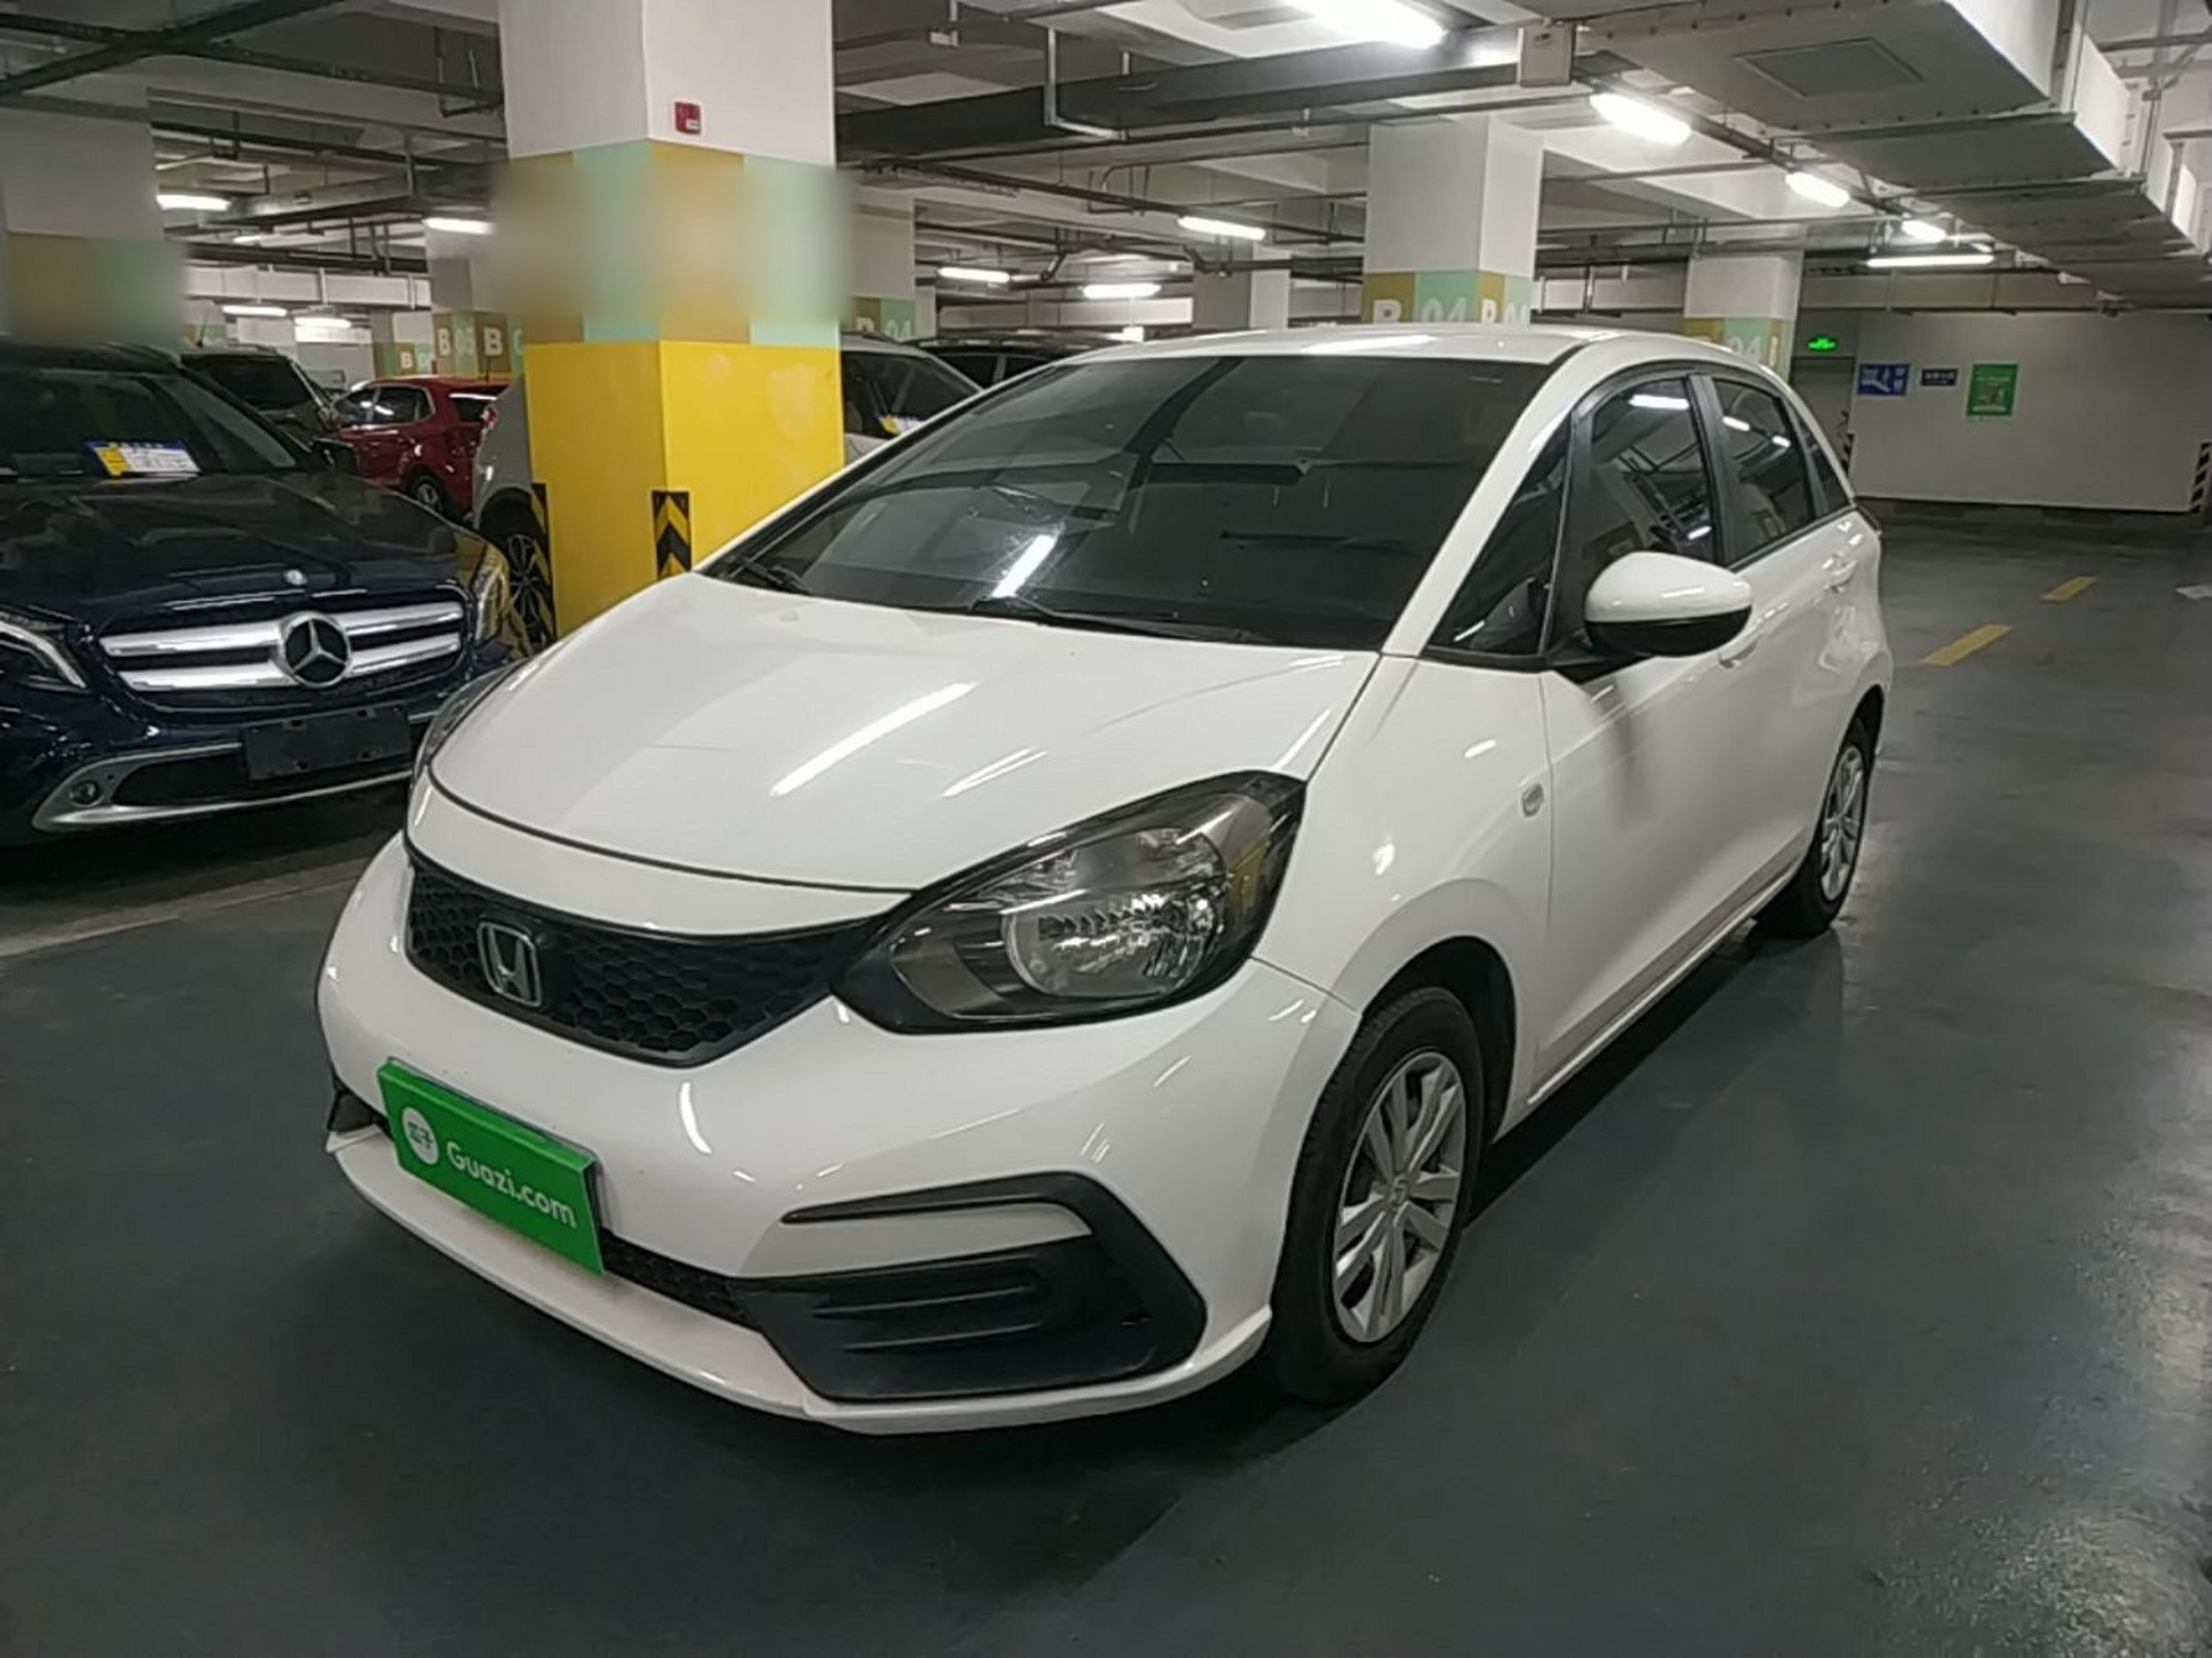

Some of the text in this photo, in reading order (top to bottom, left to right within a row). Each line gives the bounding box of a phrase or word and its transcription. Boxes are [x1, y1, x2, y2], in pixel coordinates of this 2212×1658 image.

[437, 328, 450, 356] B
[484, 327, 503, 356] B
[446, 1141, 576, 1228] Guazi.com
